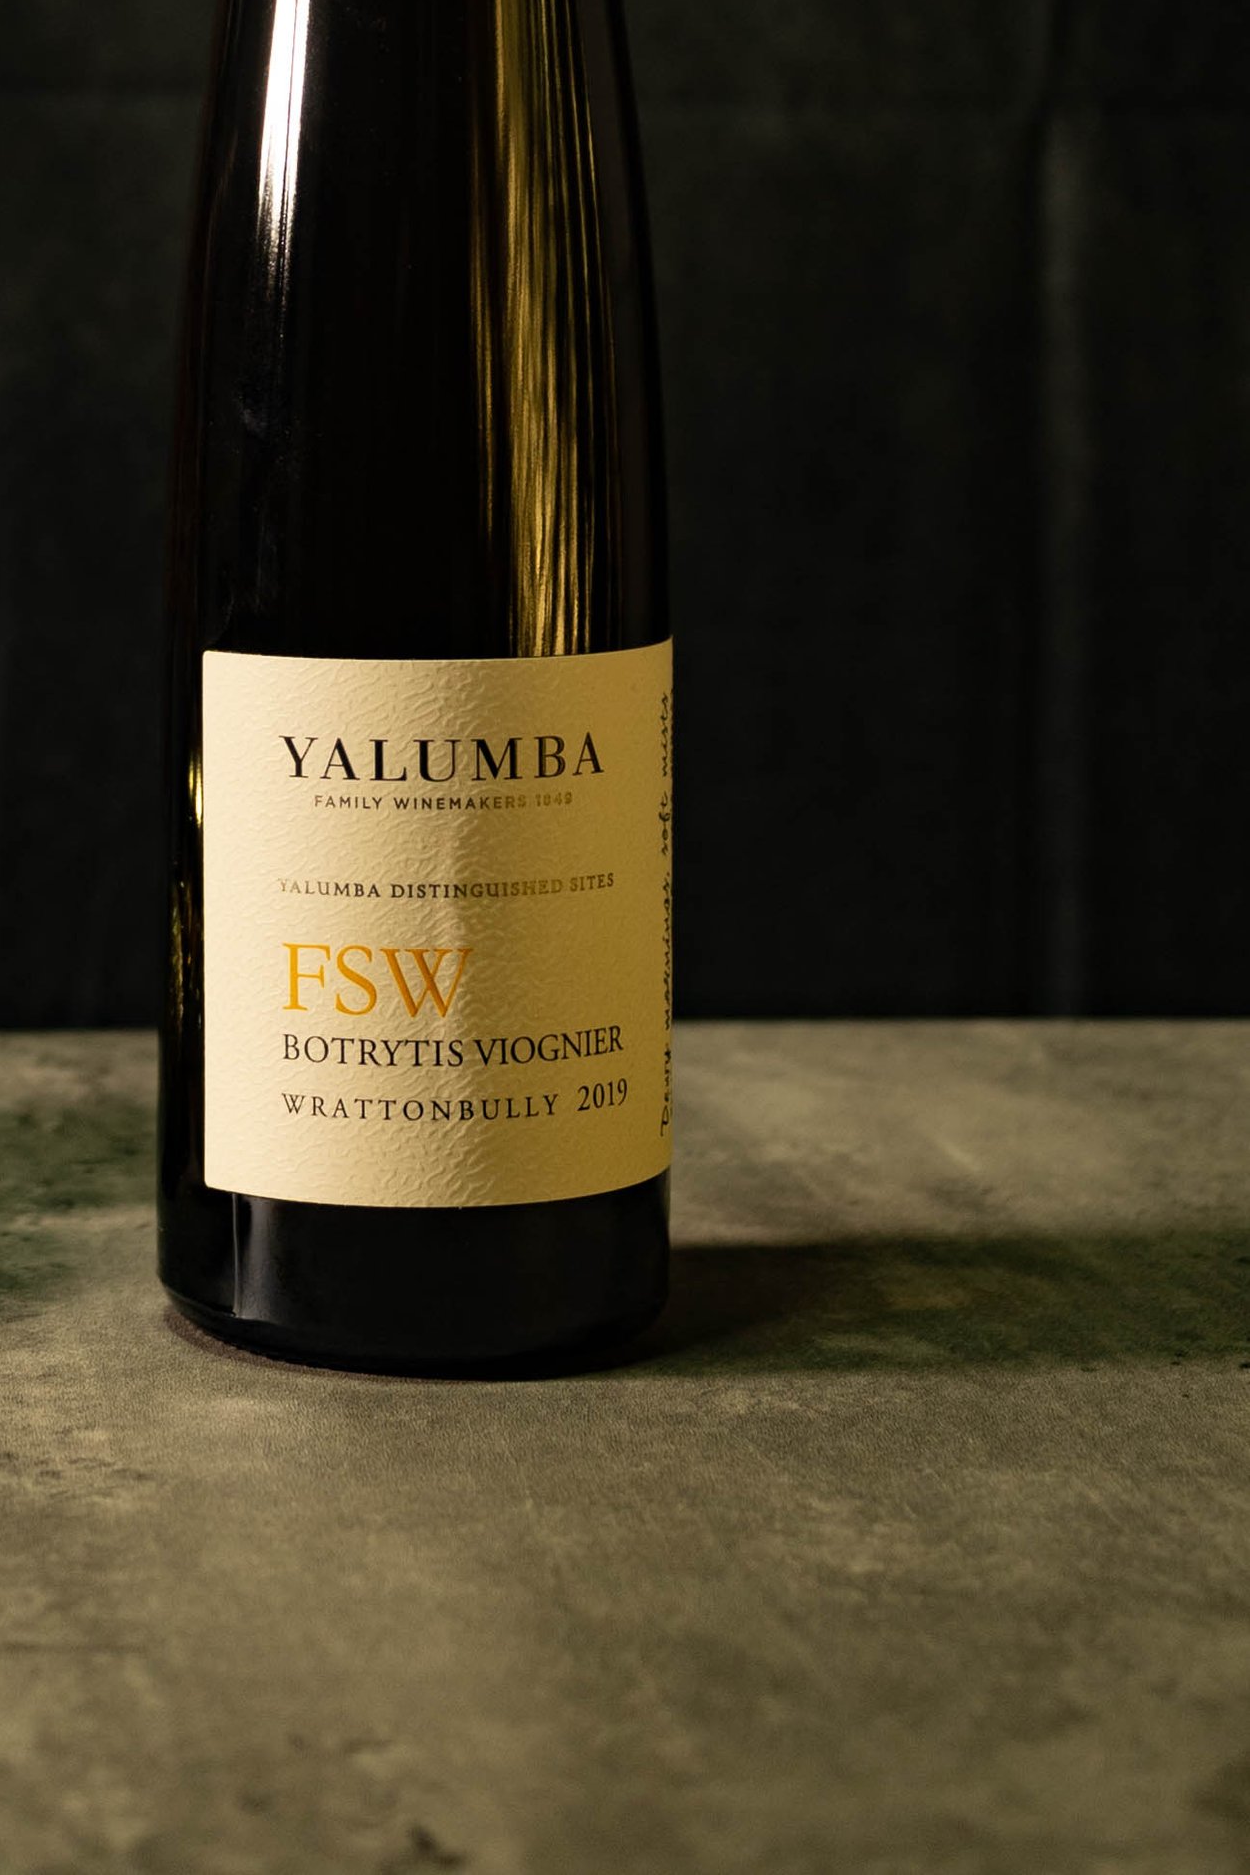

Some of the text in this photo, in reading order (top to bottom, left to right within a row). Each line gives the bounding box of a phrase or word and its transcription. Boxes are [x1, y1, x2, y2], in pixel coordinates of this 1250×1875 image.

[278, 730, 605, 783] YALUMBA
[313, 791, 573, 811] FAMILY WINEMAKERS 1849
[278, 872, 615, 900] YALUMBA DISTINGUISHED SITES
[281, 942, 474, 1018] FSW
[282, 1024, 625, 1068] BOTRYTIS VIOGNIER
[281, 1078, 629, 1121] WRATTONBULLY 2019
